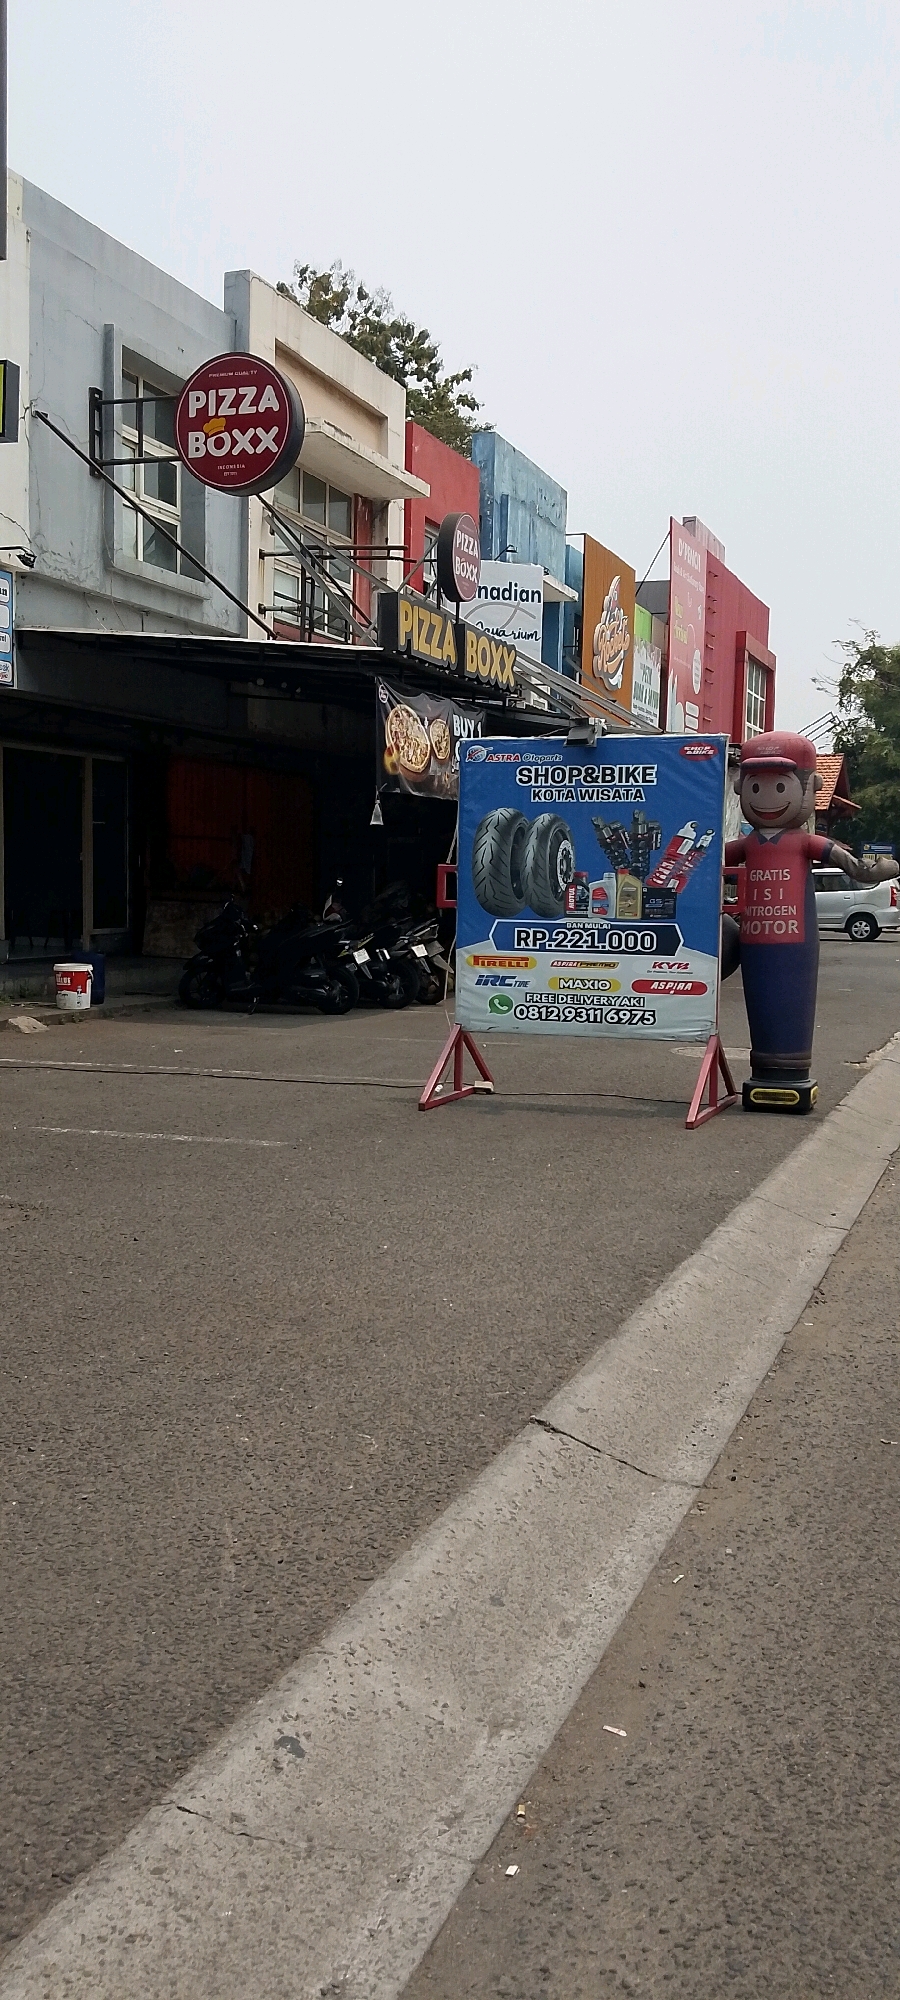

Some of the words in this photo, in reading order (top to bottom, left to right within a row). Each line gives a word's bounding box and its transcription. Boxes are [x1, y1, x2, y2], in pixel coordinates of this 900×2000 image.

[188, 384, 280, 418] PIZZA
[187, 426, 279, 459] BOXX
[456, 529, 479, 557] PIZZA
[455, 556, 478, 584] BOXX
[477, 581, 541, 604] nadian
[400, 600, 456, 665] PIZZA
[466, 630, 516, 688] BOXX
[452, 712, 474, 739] BUY
[486, 753, 520, 762] ASTRA
[516, 764, 658, 787] SHOP&BIKE
[531, 788, 577, 802] KOTA
[578, 787, 646, 802] WISATA
[750, 869, 791, 882] GRATIS
[568, 887, 576, 910] MOTUL
[745, 905, 797, 916] NITROGEN
[741, 919, 799, 935] MOTOR
[514, 928, 657, 953] RP.221.000
[473, 955, 530, 968] PIRELLI
[652, 962, 690, 970] KYB
[559, 978, 611, 991] MAXIO
[650, 982, 693, 992] ASPIRA
[525, 992, 556, 1004] FREE
[557, 993, 619, 1006] DELIVERY
[619, 996, 646, 1007] AKI
[514, 1004, 561, 1022] 0812
[561, 1005, 603, 1024] 9311
[604, 1008, 657, 1026] 6975
